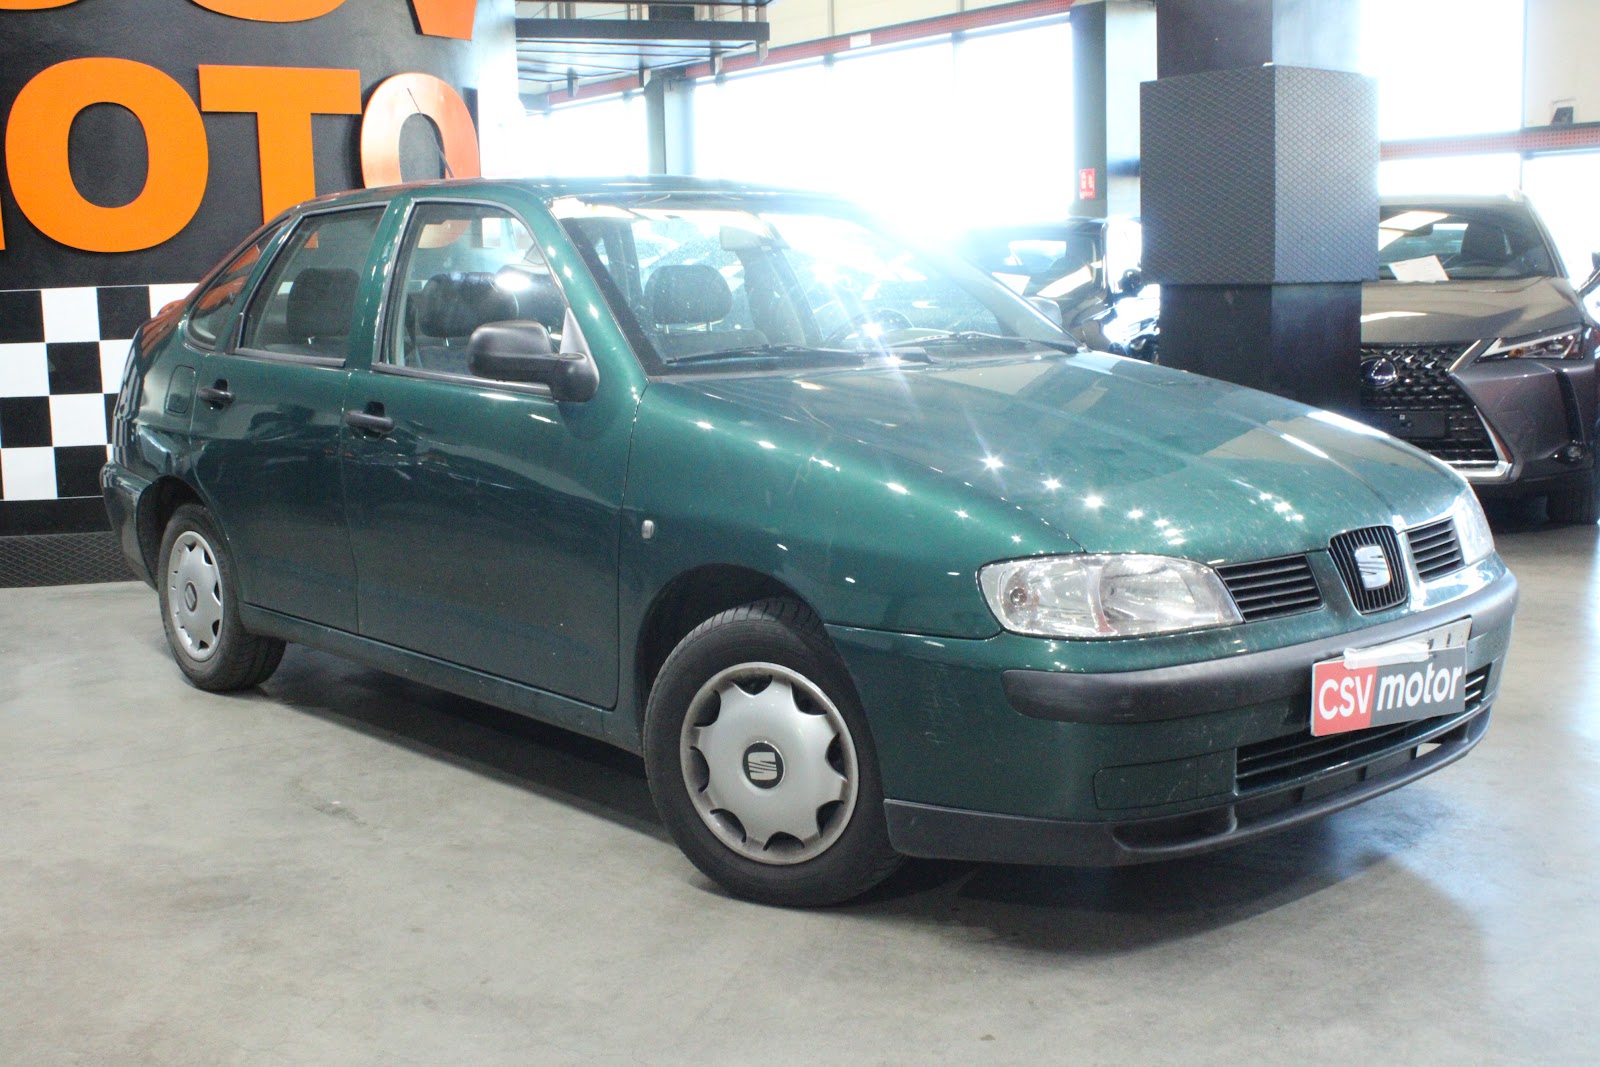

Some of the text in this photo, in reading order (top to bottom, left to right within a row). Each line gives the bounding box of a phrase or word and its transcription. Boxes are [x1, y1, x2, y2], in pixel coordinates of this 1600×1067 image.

[0, 57, 481, 252] OTO
[1318, 662, 1463, 721] CSV motor
